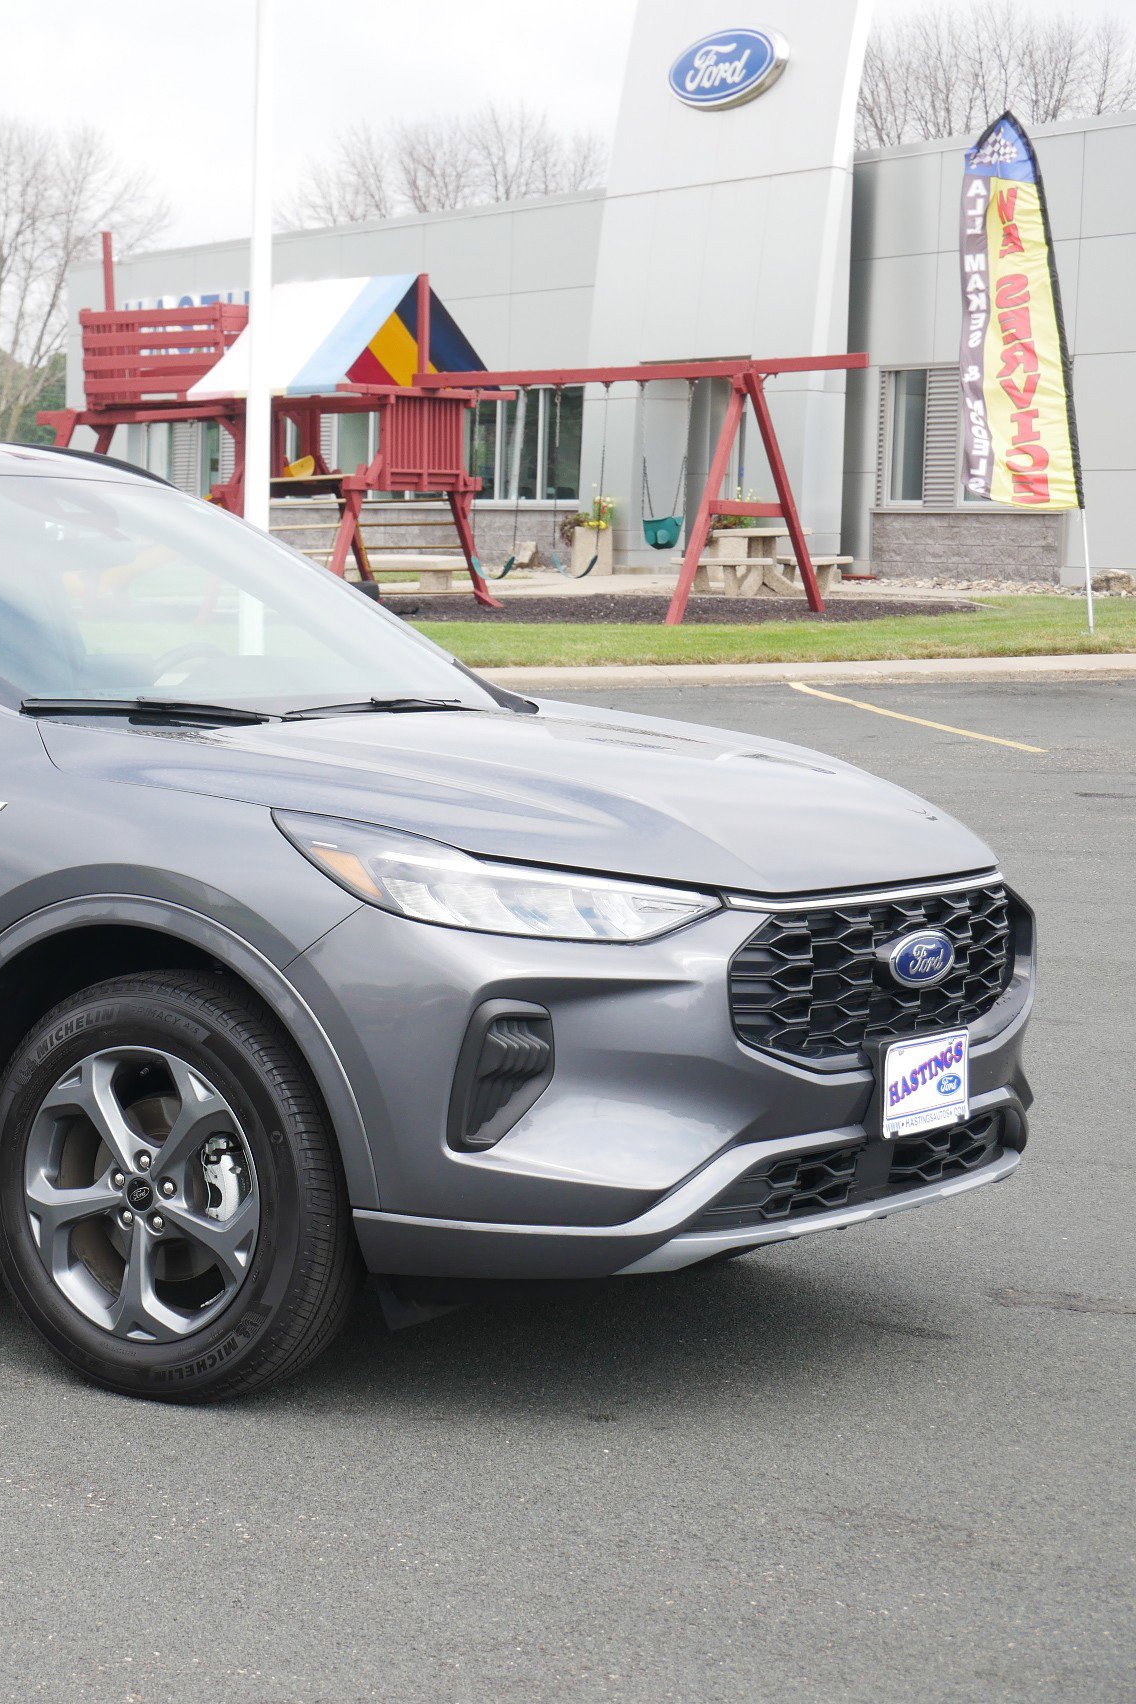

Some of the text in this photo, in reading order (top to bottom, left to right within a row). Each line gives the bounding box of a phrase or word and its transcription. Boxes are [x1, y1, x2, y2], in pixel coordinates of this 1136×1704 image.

[684, 42, 752, 92] Ford
[909, 943, 944, 975] Ford
[36, 1006, 121, 1060] MICHELIN
[129, 1004, 182, 1025] PRIMACY
[889, 1040, 963, 1107] HASTINGS
[154, 1337, 239, 1382] MICHELIN
